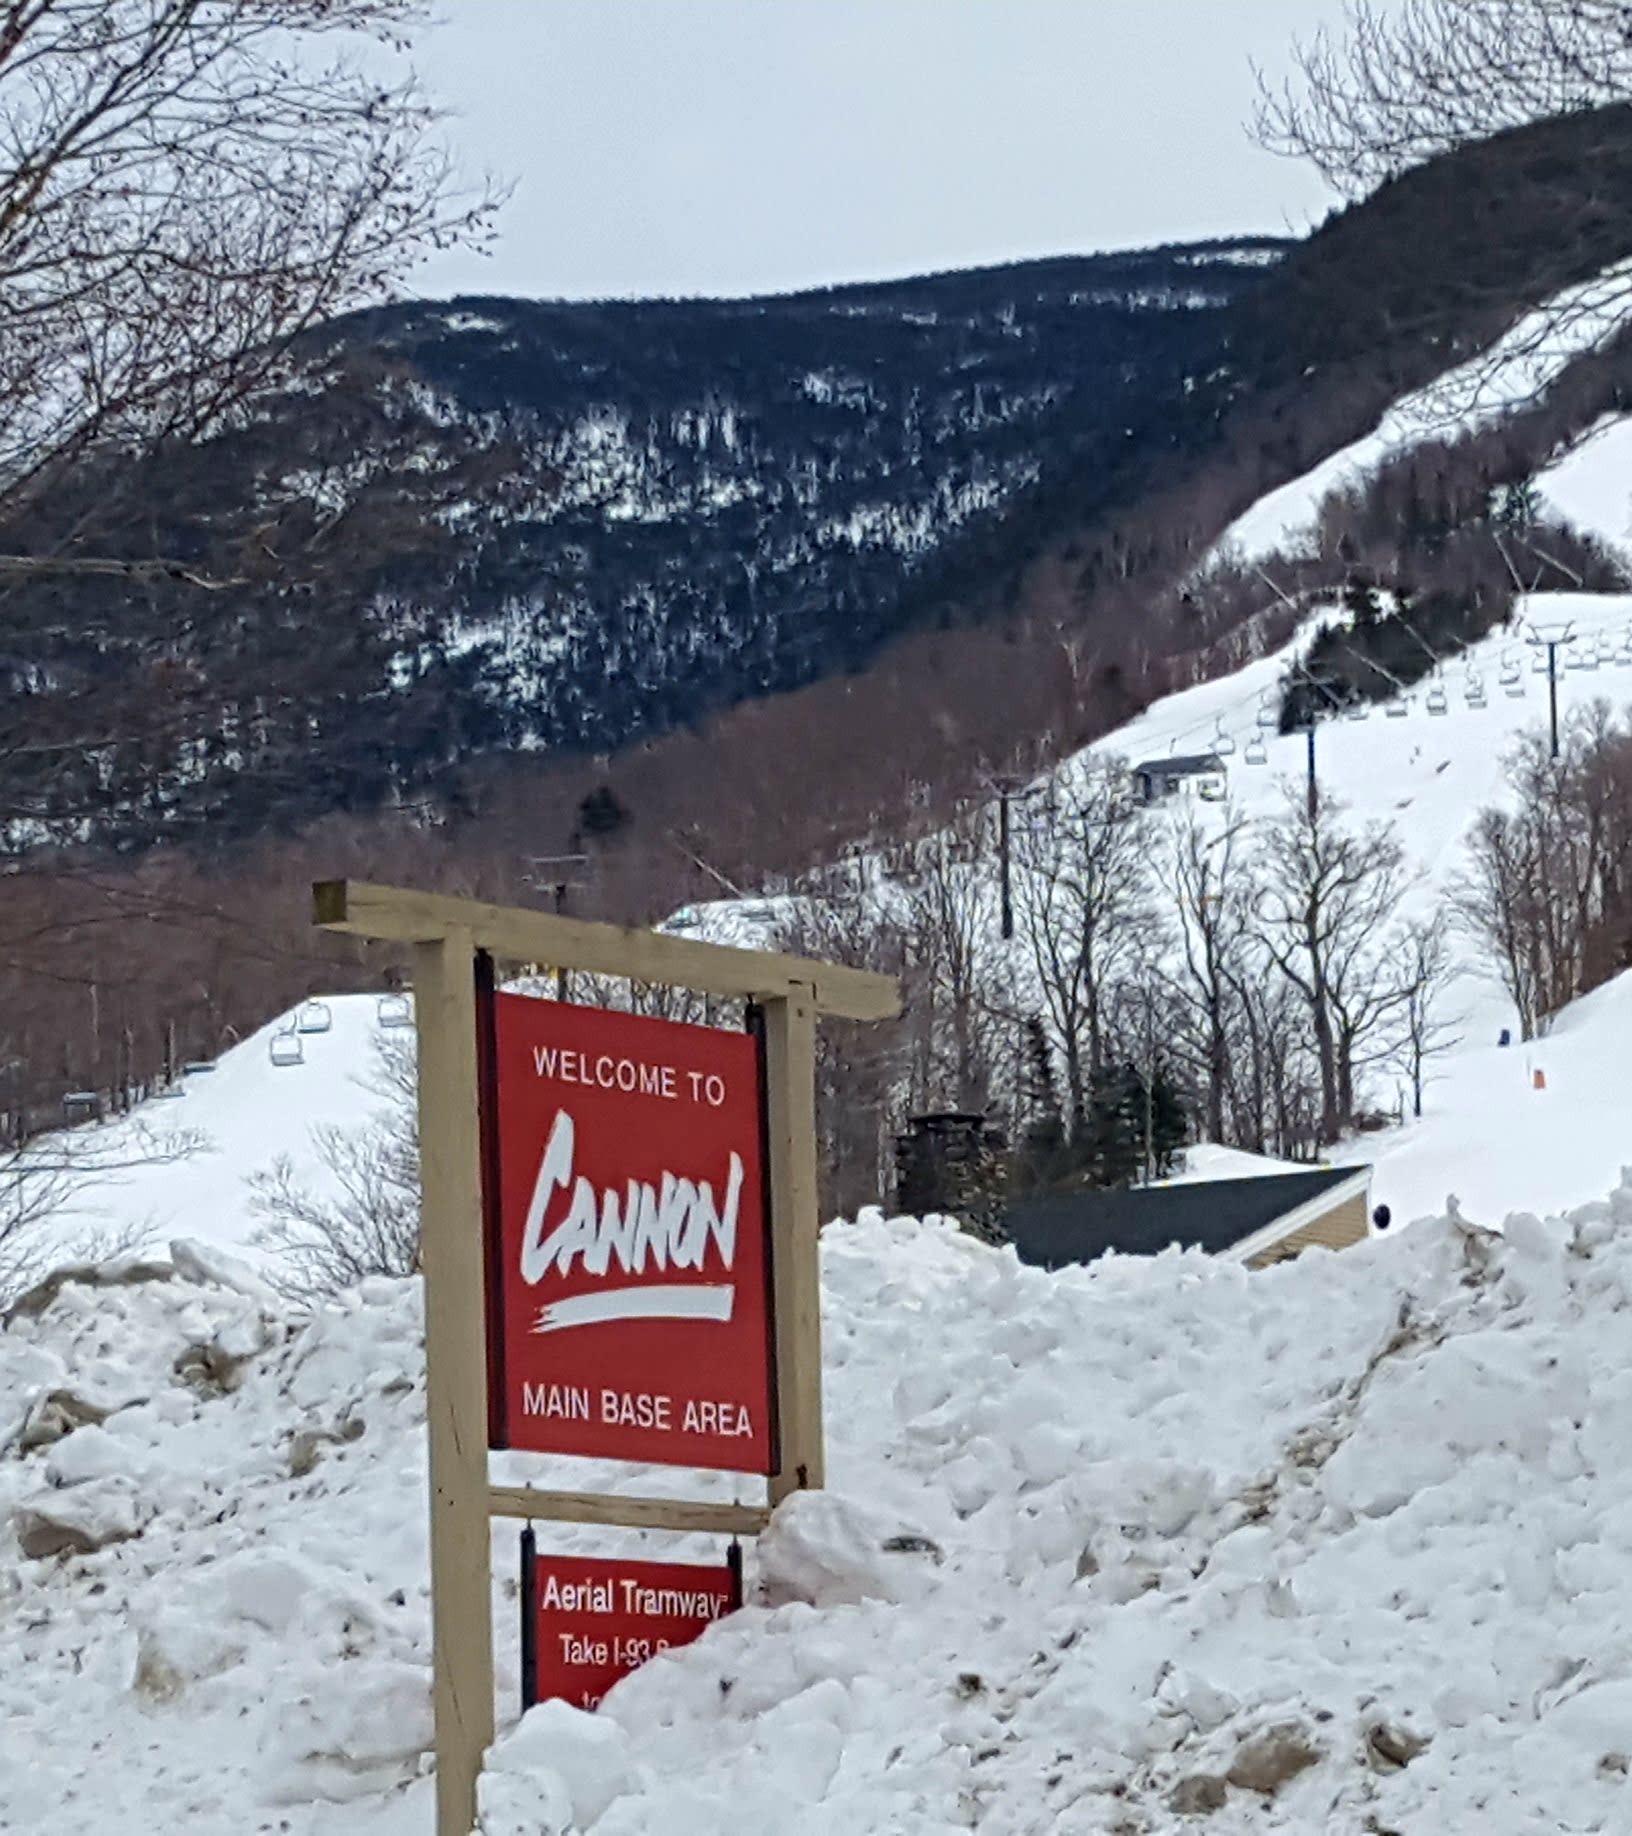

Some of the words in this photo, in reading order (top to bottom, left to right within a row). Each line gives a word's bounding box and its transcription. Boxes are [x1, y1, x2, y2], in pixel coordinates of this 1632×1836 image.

[532, 1046, 678, 1098] WELCOME
[687, 1071, 725, 1106] TO
[520, 1108, 744, 1285] CANNON
[523, 1382, 589, 1420] MAIN
[601, 1390, 671, 1430] BASE
[682, 1400, 753, 1438] AREA
[542, 1576, 613, 1612] Aerial
[559, 1633, 608, 1665] Take
